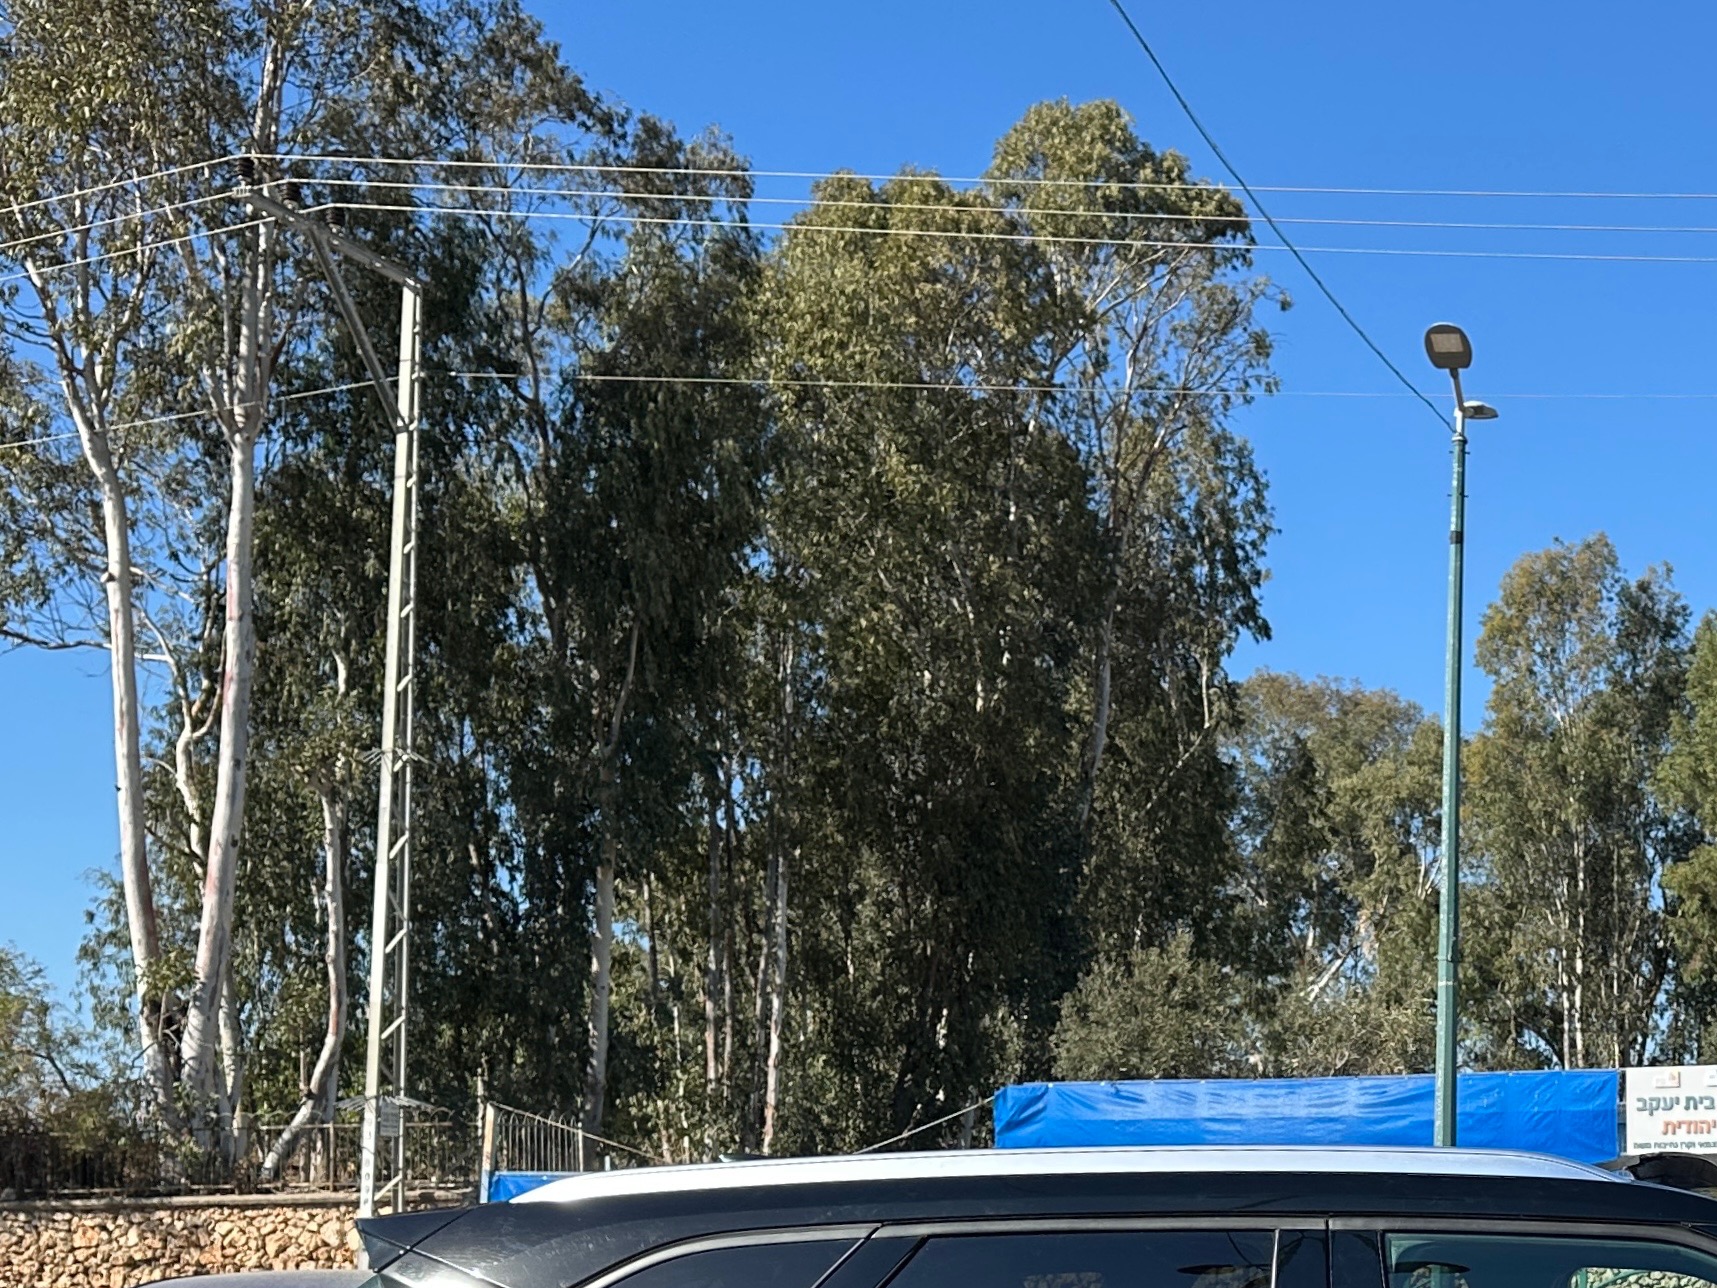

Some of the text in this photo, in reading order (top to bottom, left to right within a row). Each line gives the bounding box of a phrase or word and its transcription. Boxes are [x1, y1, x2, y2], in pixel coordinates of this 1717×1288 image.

[1636, 1096, 1680, 1116] יעקב
[1684, 1095, 1716, 1111] בית
[1662, 1118, 1717, 1136] יהודית
